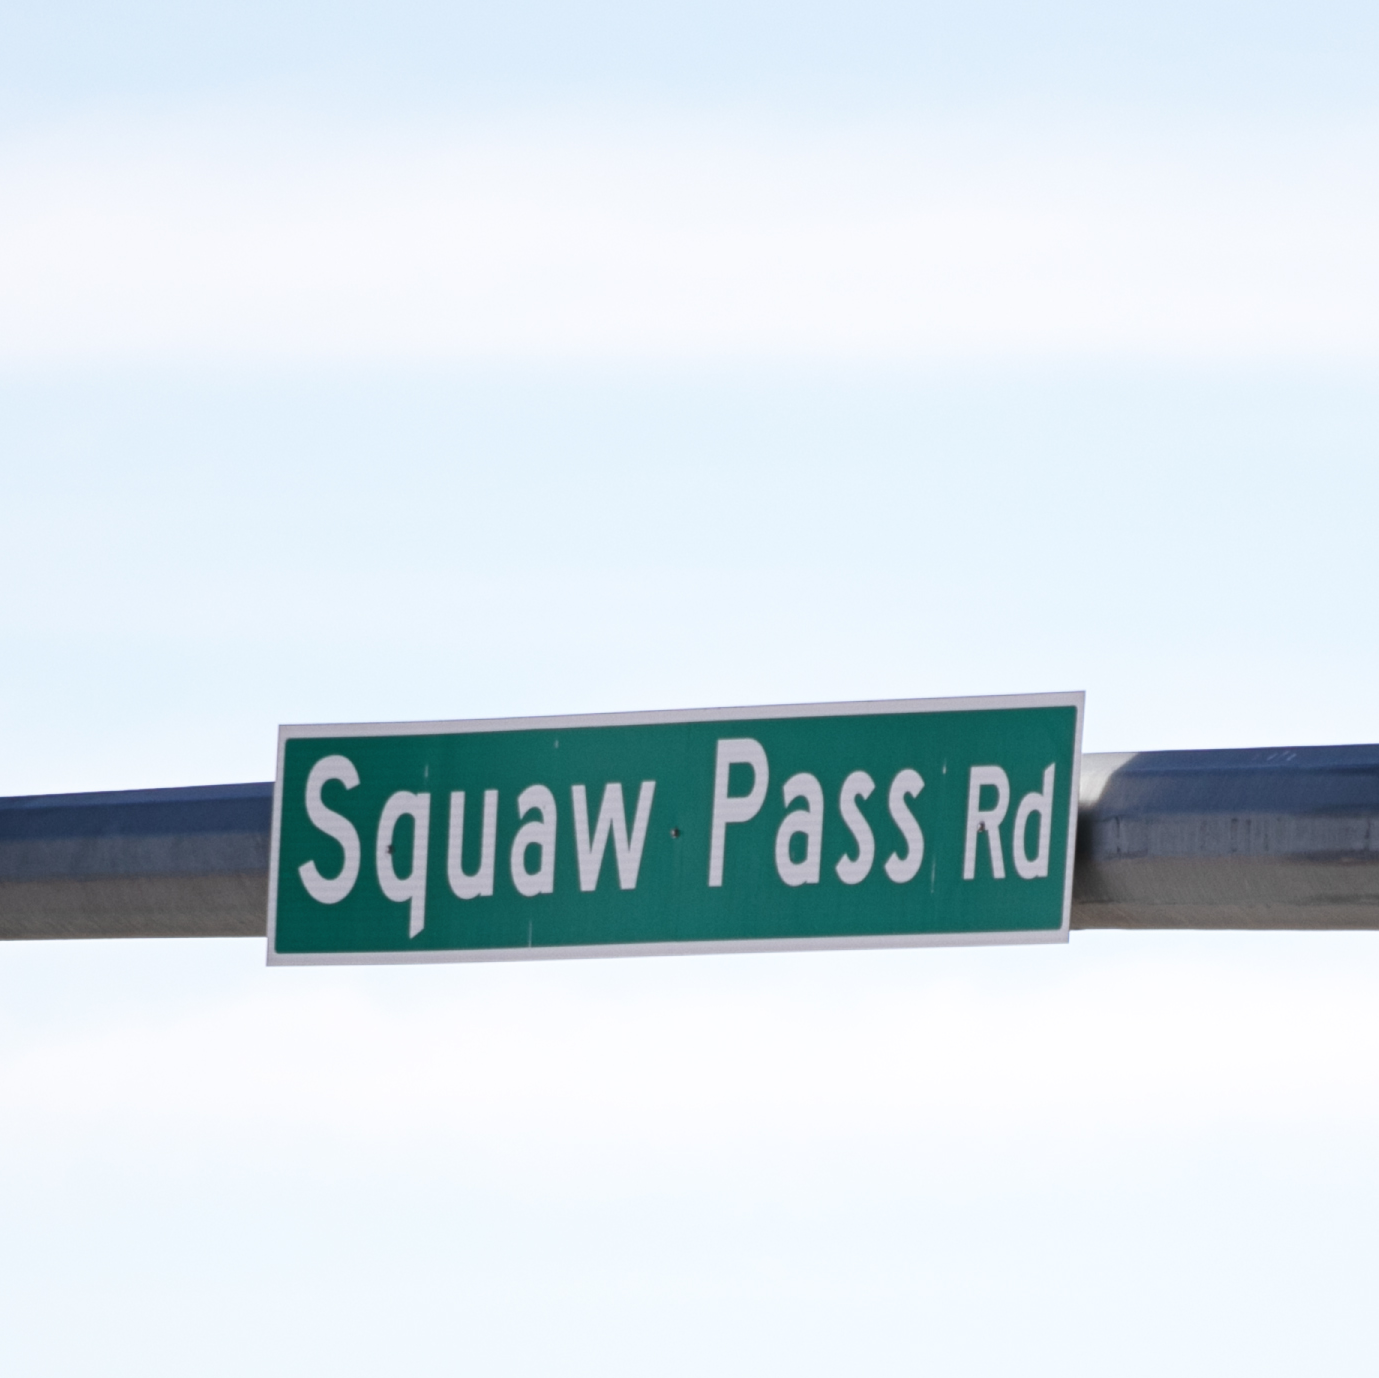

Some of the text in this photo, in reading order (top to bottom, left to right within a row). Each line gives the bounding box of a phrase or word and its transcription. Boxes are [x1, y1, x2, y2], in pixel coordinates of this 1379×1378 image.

[297, 737, 1056, 938] Squaw Pass Rd
